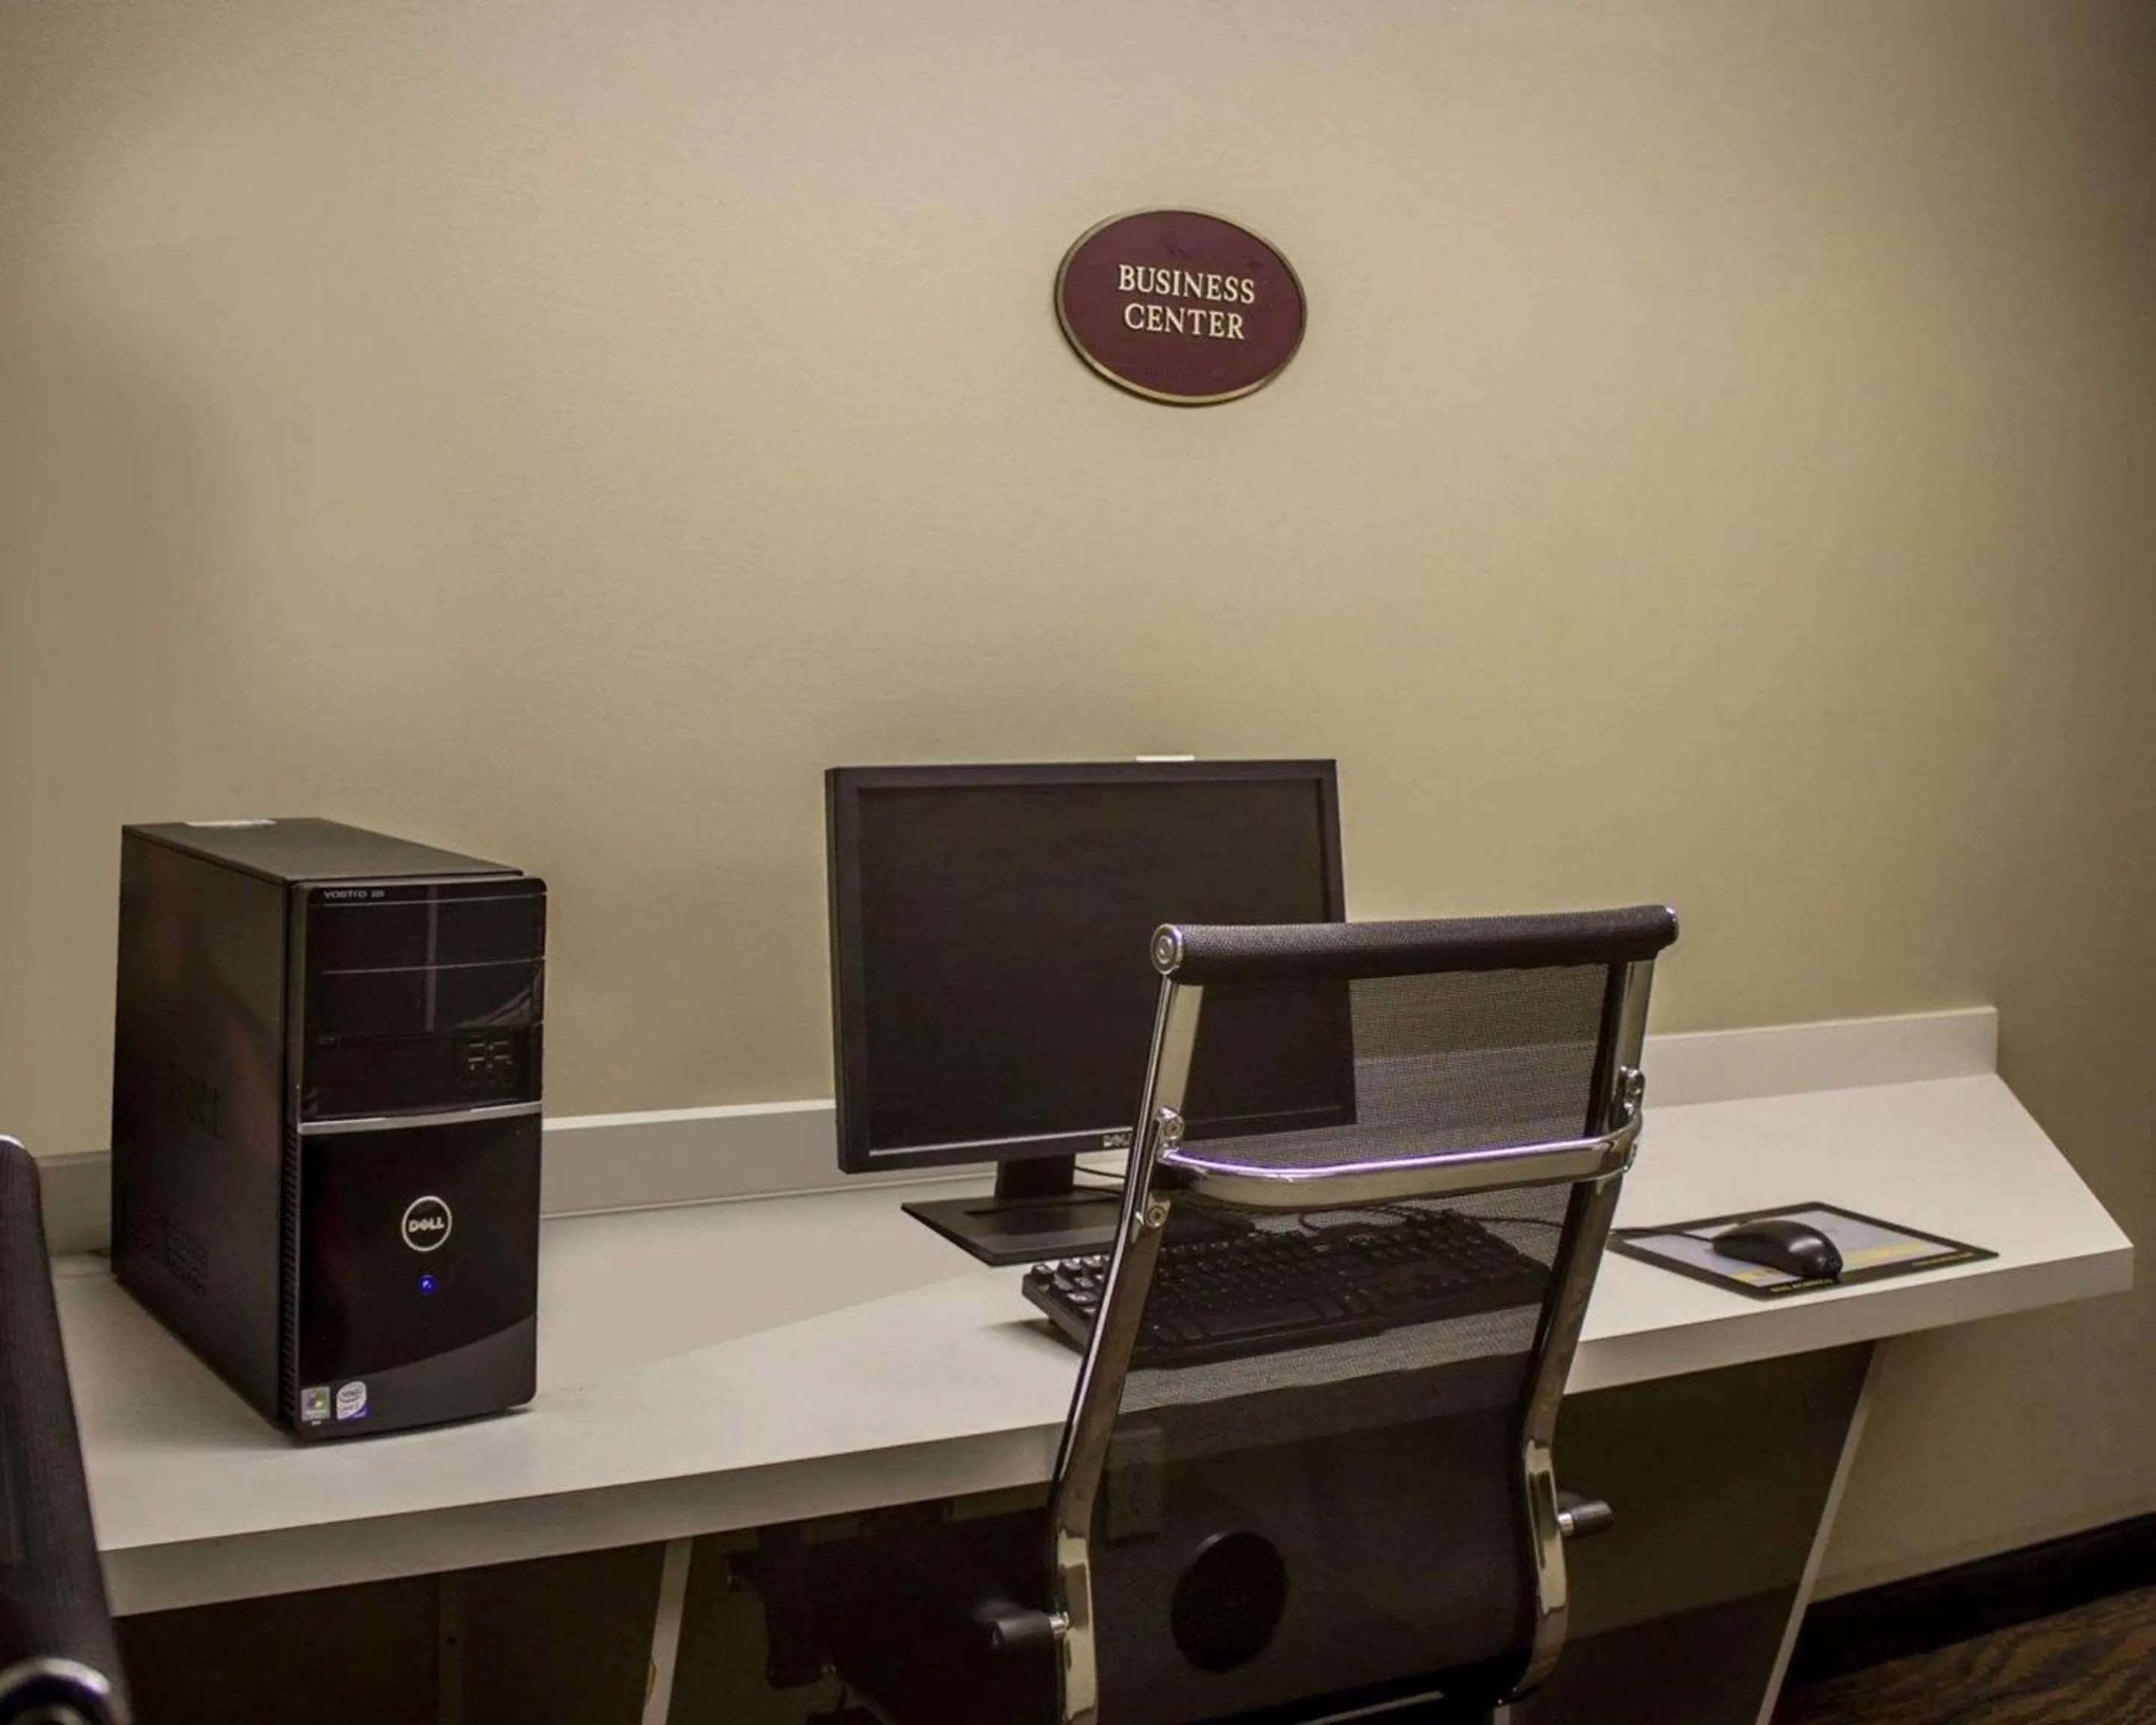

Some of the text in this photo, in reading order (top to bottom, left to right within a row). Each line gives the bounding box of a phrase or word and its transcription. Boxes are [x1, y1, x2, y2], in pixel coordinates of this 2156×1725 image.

[1118, 264, 1255, 304] BUSINESS
[1124, 302, 1245, 340] CENTER
[408, 1216, 445, 1233] DELL
